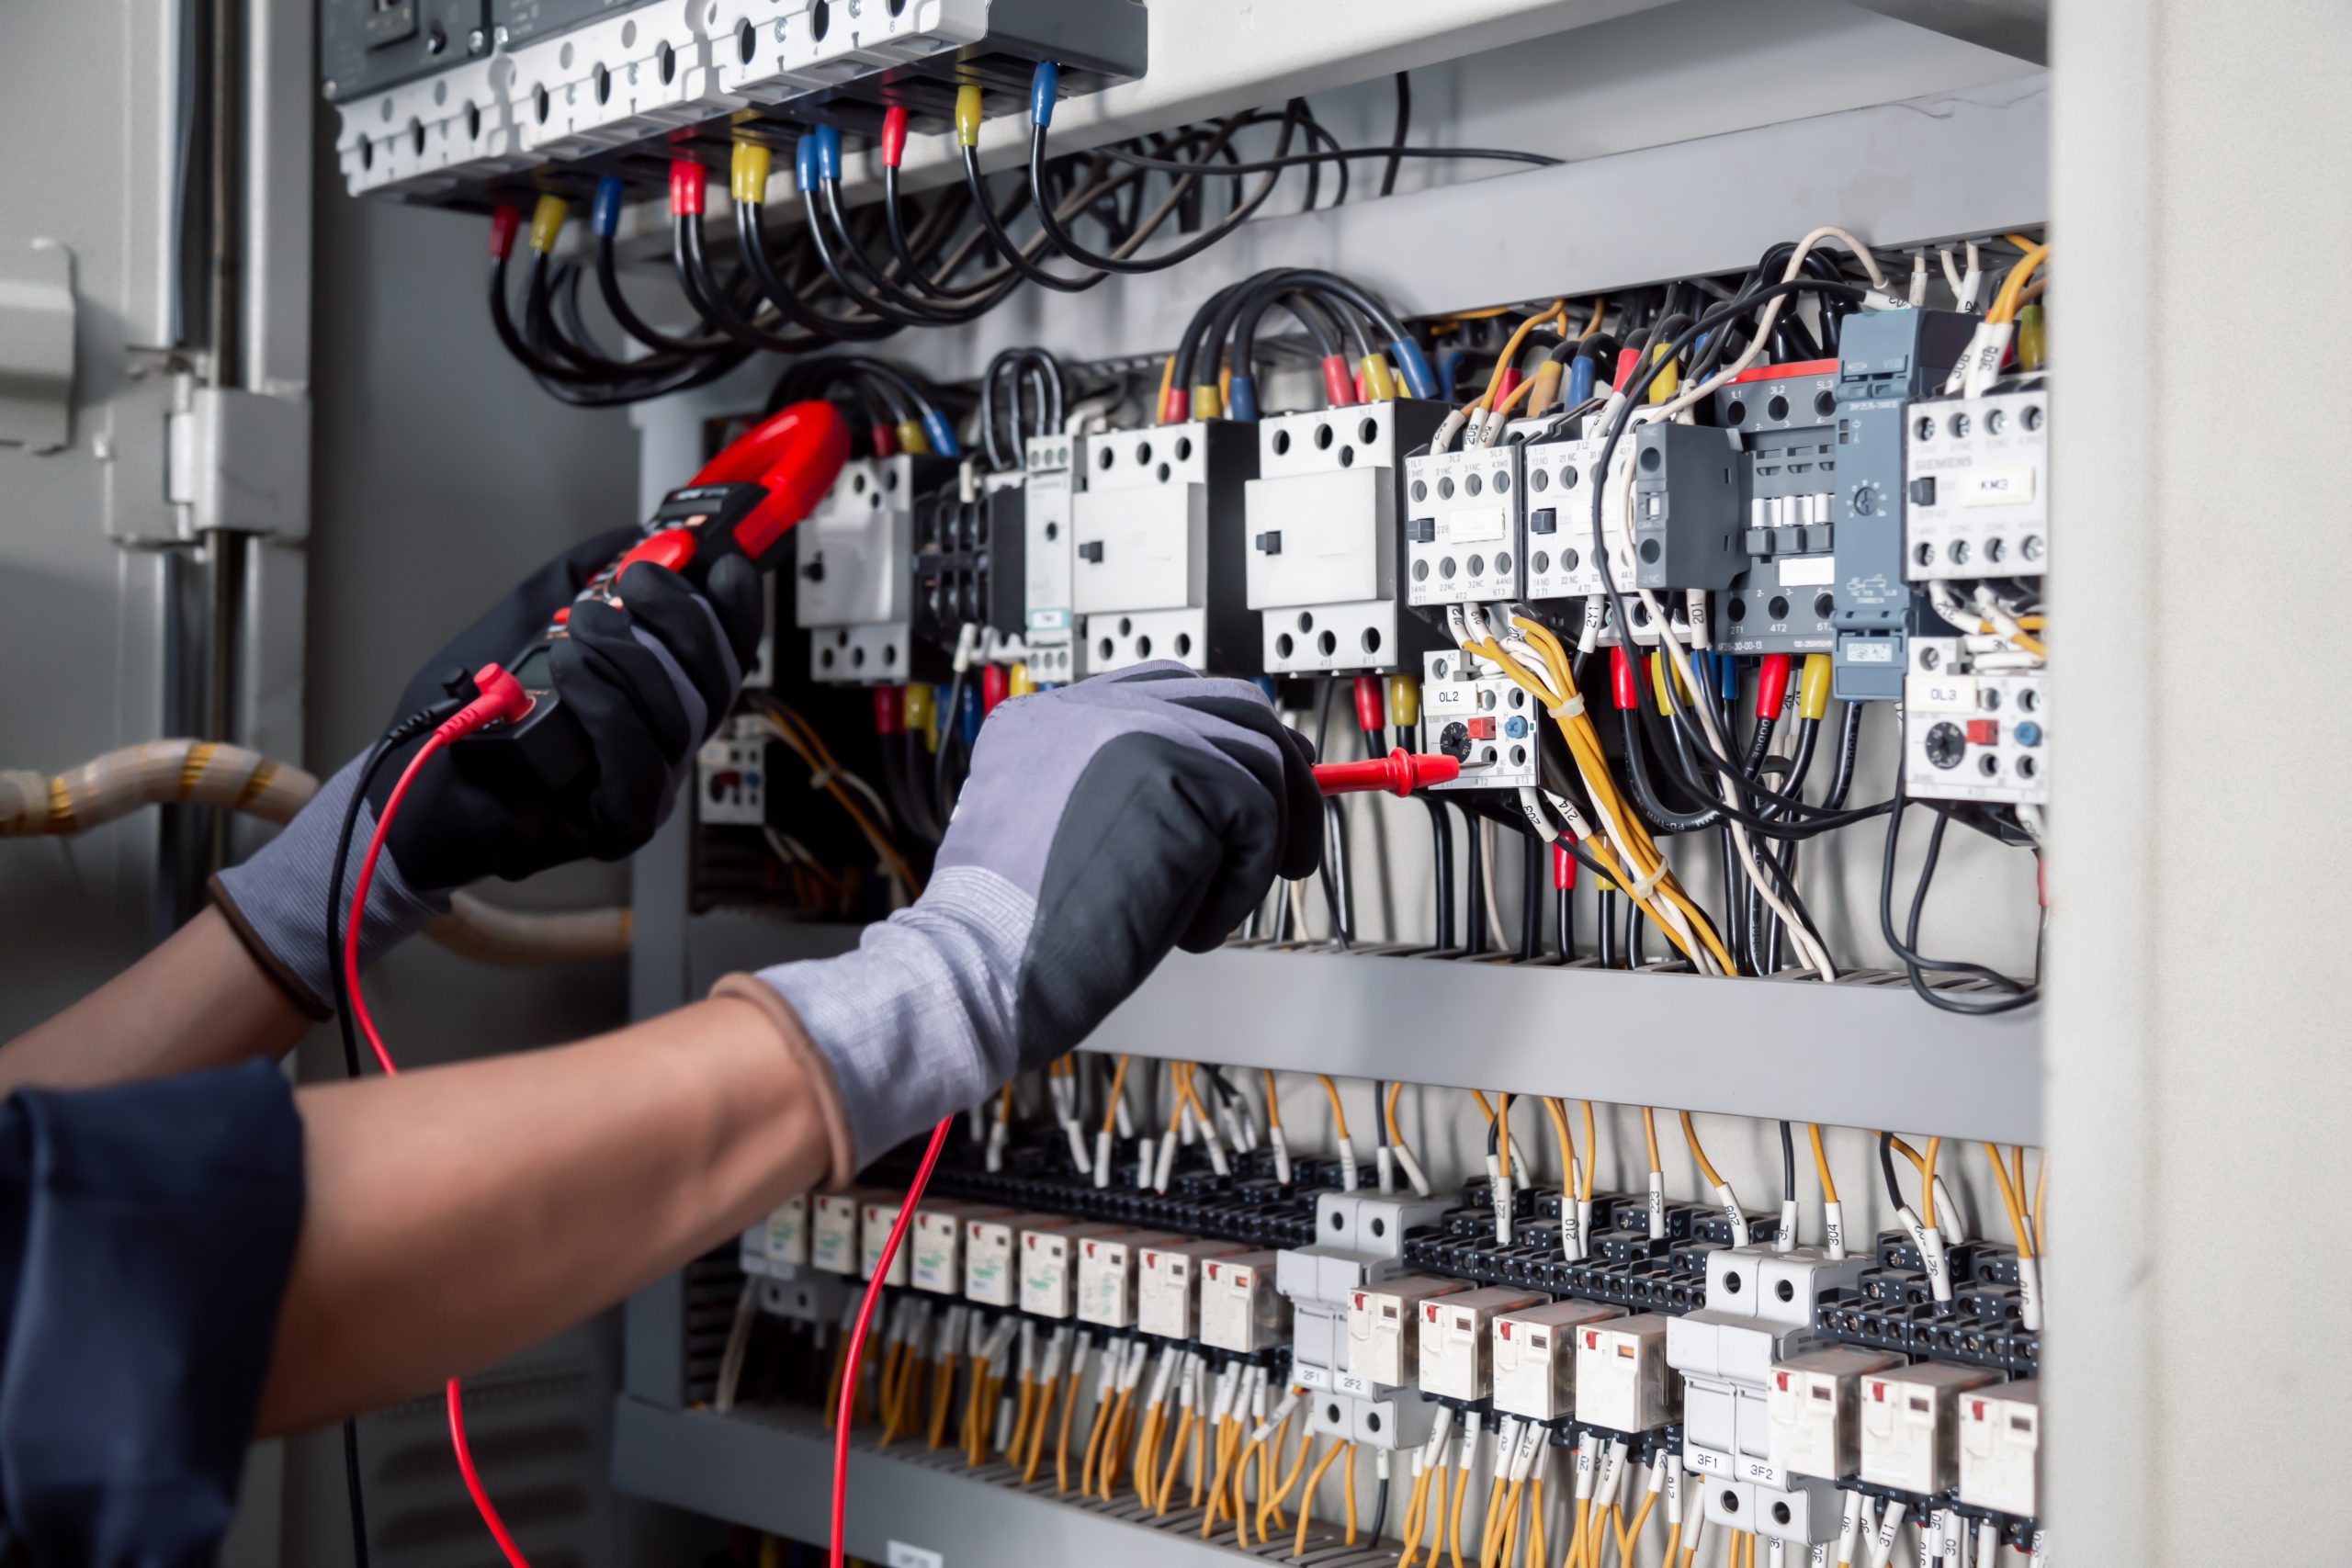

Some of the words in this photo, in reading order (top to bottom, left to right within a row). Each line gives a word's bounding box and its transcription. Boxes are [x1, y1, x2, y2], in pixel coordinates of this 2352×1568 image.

[1770, 385, 1786, 395] 3L2
[1489, 447, 1503, 457] 5L3
[1914, 456, 1973, 470] SIEMENS
[1436, 525, 1451, 535] 22E
[1439, 582, 1456, 592] 22NC
[1467, 580, 1485, 589] 32NC
[1496, 577, 1513, 586] 44NO
[1454, 592, 1468, 601] 4T2
[1586, 606, 1600, 628] 2Y1
[1730, 626, 1744, 635] 2T1
[1770, 624, 1787, 633] 4T2
[1558, 799, 1578, 821] 214
[1497, 1199, 1506, 1219] 221
[1650, 1190, 1660, 1214] 223
[1725, 1205, 1740, 1227] 208
[1565, 1218, 1576, 1241] 210
[1827, 1224, 1839, 1247] 304
[1343, 1377, 1362, 1391] 2F2
[1579, 1455, 1589, 1472] 20
[1697, 1453, 1717, 1469] 3F1
[1750, 1464, 1773, 1481] 3F2
[1931, 1513, 1942, 1530] 30
[1879, 1523, 1895, 1548] 311
[1945, 1539, 1957, 1557] 30
